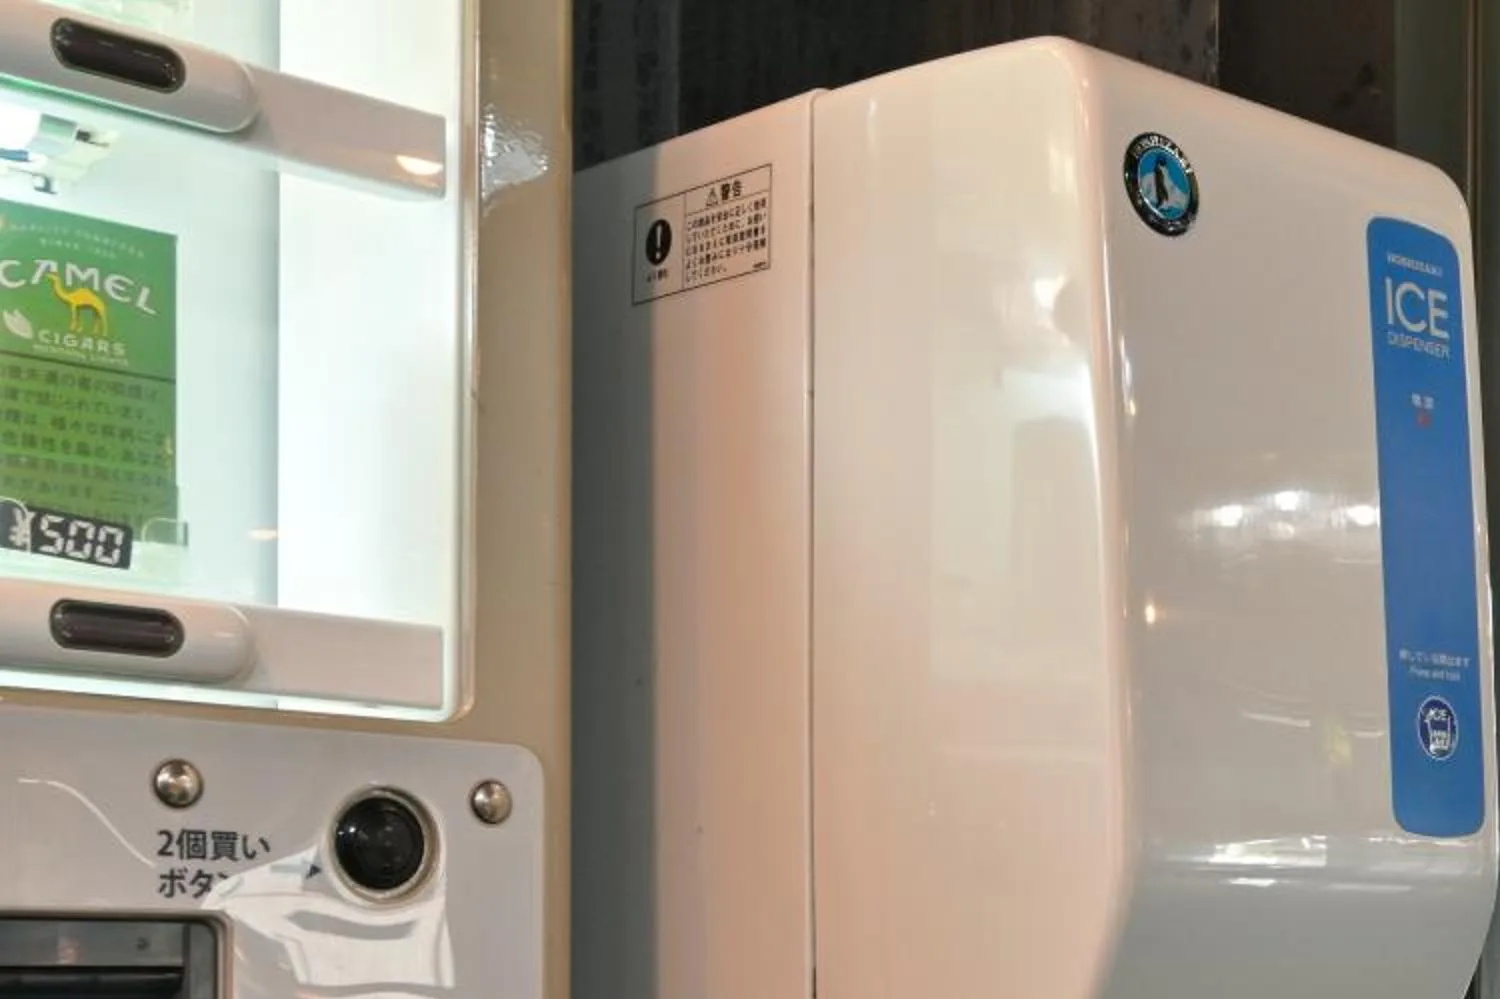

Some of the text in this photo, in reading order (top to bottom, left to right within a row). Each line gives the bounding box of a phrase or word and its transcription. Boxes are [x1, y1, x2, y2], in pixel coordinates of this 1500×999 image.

[0, 259, 157, 316] CAMEL
[1385, 276, 1449, 339] ICE
[38, 329, 126, 357] CIGARS
[8, 507, 125, 566] ¥500
[157, 829, 271, 862] 2個買い
